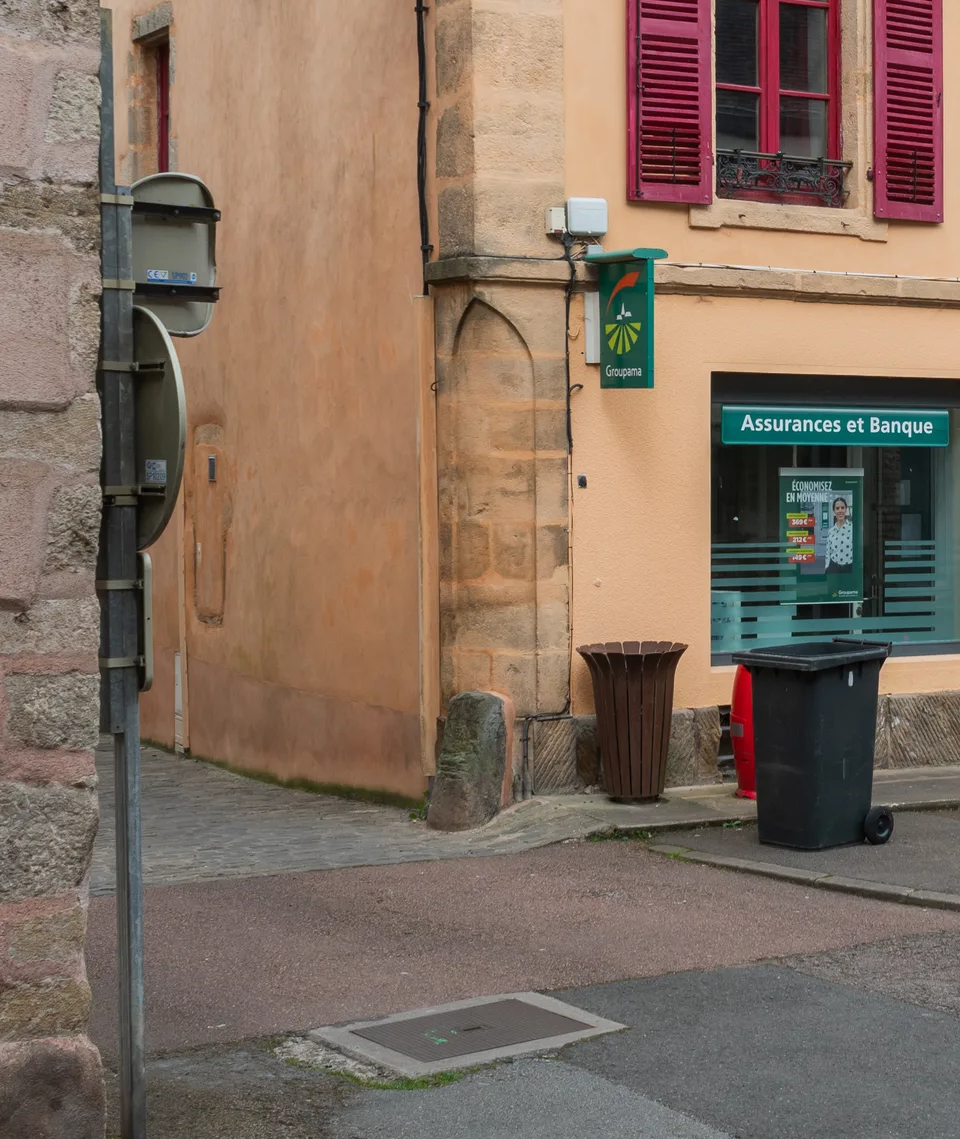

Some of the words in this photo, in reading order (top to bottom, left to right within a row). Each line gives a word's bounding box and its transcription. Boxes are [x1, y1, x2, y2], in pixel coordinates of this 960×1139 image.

[605, 364, 642, 380] Groupama
[741, 414, 841, 433] Assurances
[847, 417, 865, 434] et
[870, 416, 933, 438] Banque
[791, 479, 833, 491] ÉCONOMISEZ
[786, 492, 796, 503] EN
